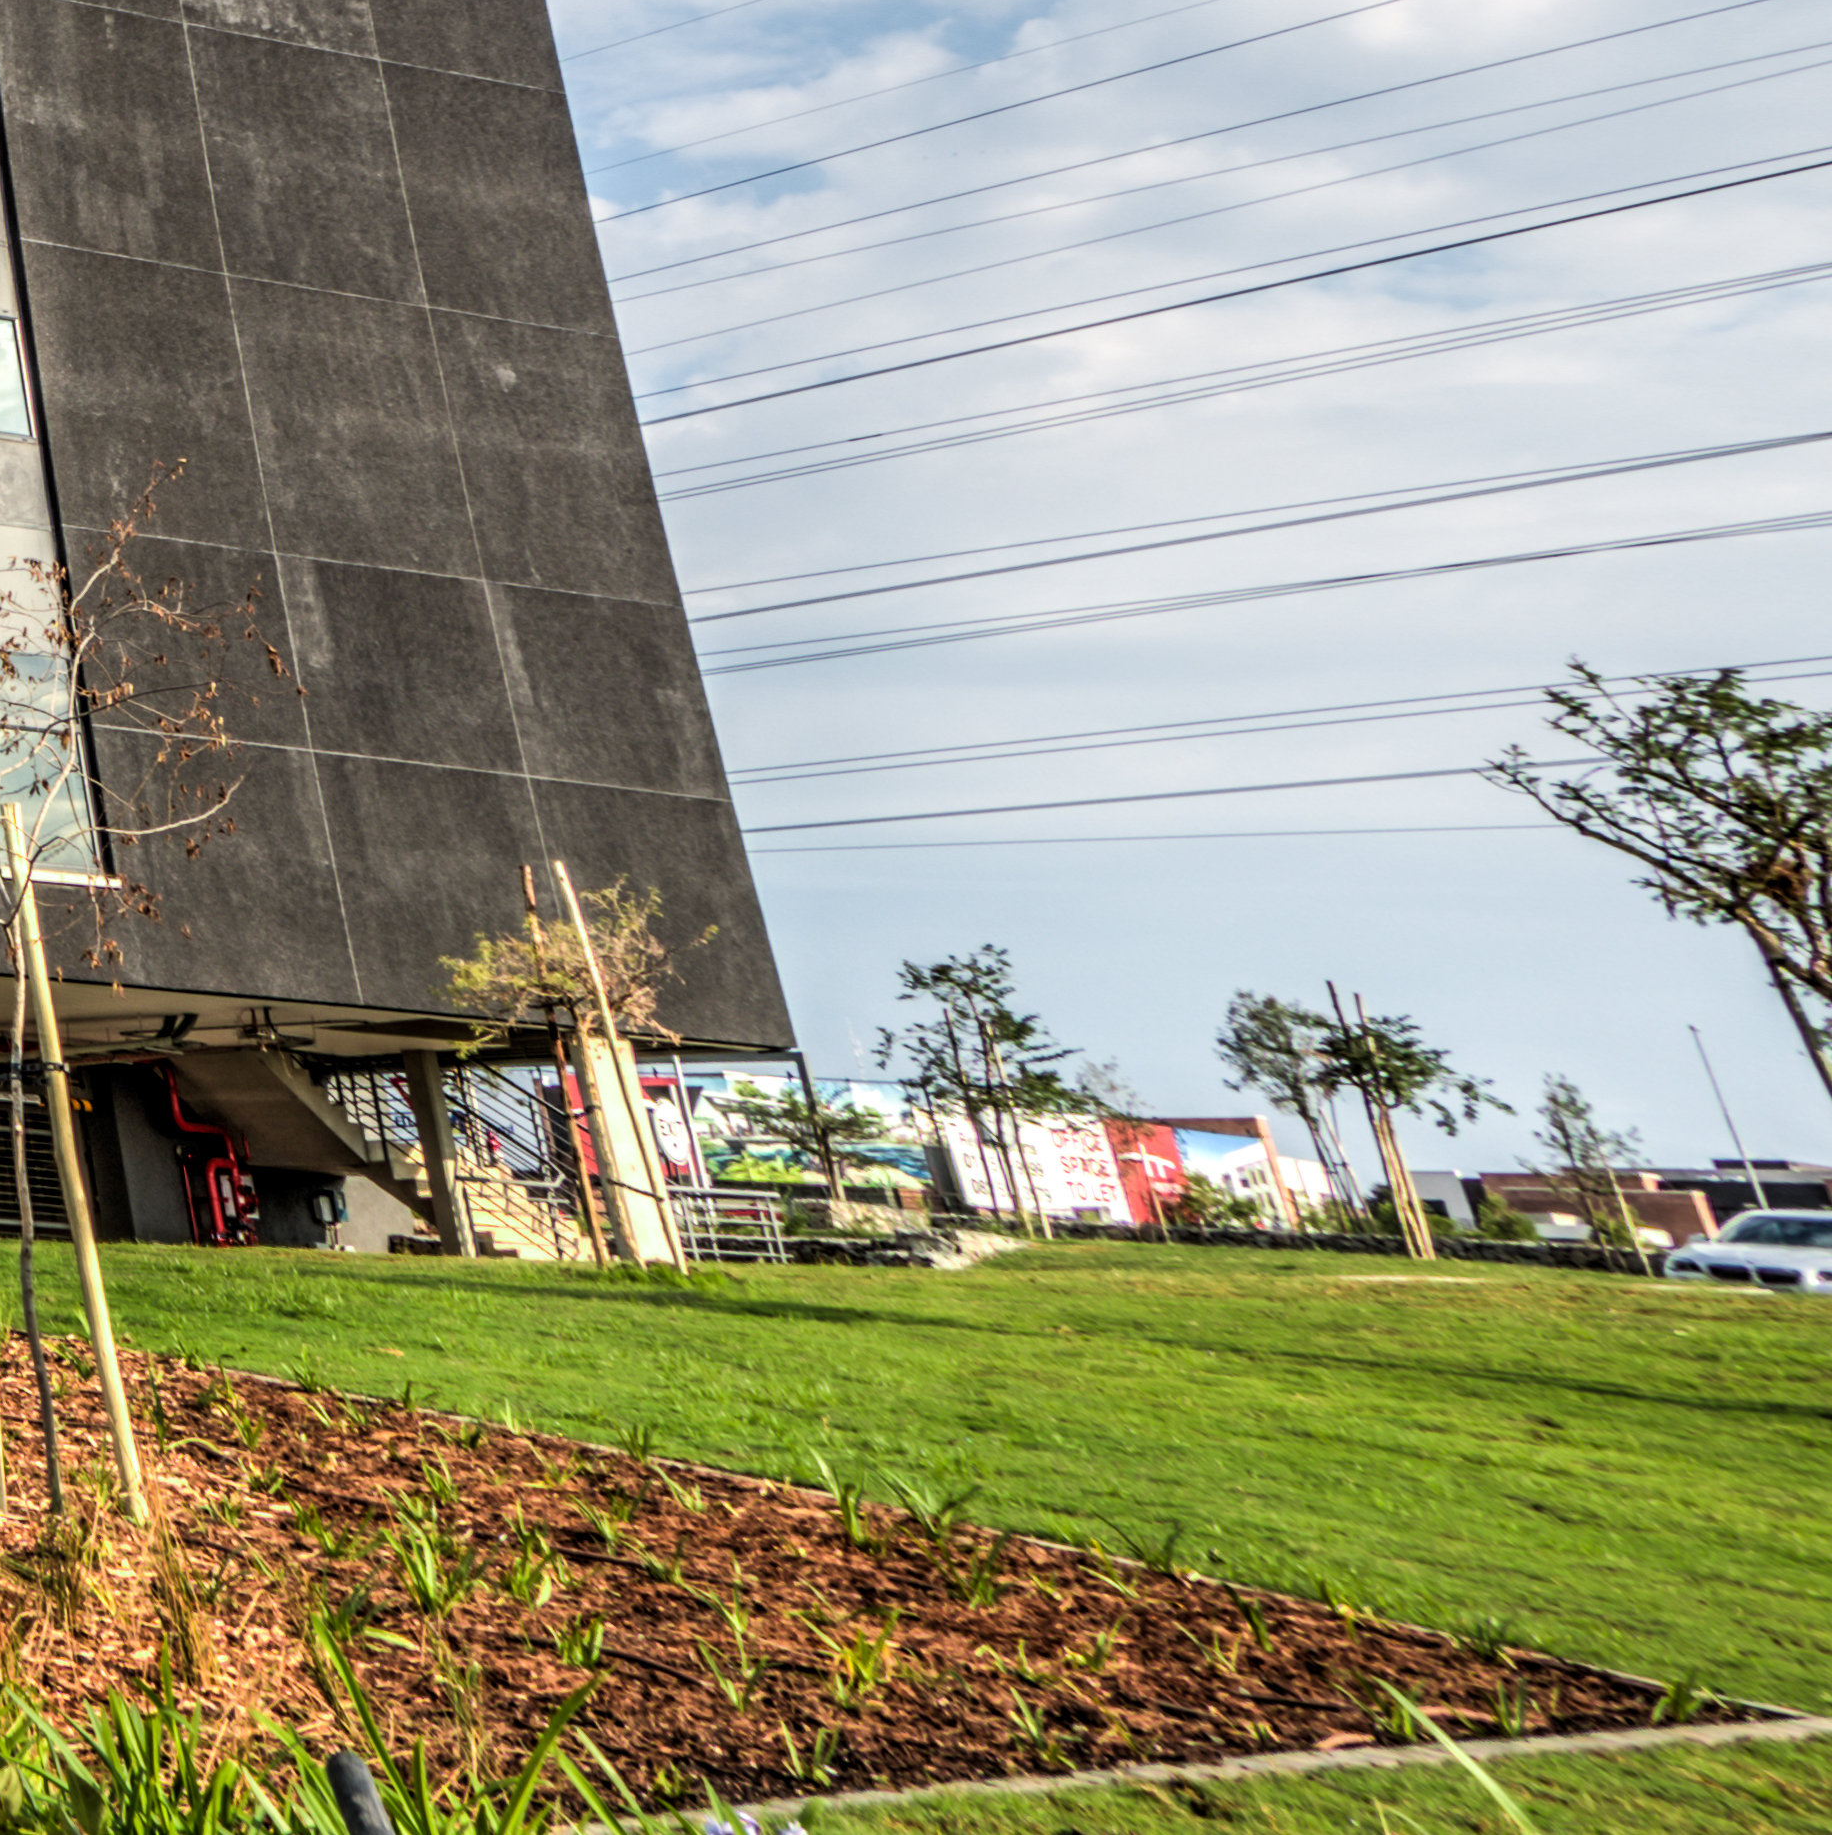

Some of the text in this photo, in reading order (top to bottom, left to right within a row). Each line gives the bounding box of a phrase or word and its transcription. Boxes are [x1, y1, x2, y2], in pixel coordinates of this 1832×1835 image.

[1052, 1129, 1103, 1152] OFFICE
[1060, 1155, 1111, 1177] SPACE
[1066, 1181, 1087, 1201] TO
[1092, 1183, 1117, 1203] LET
